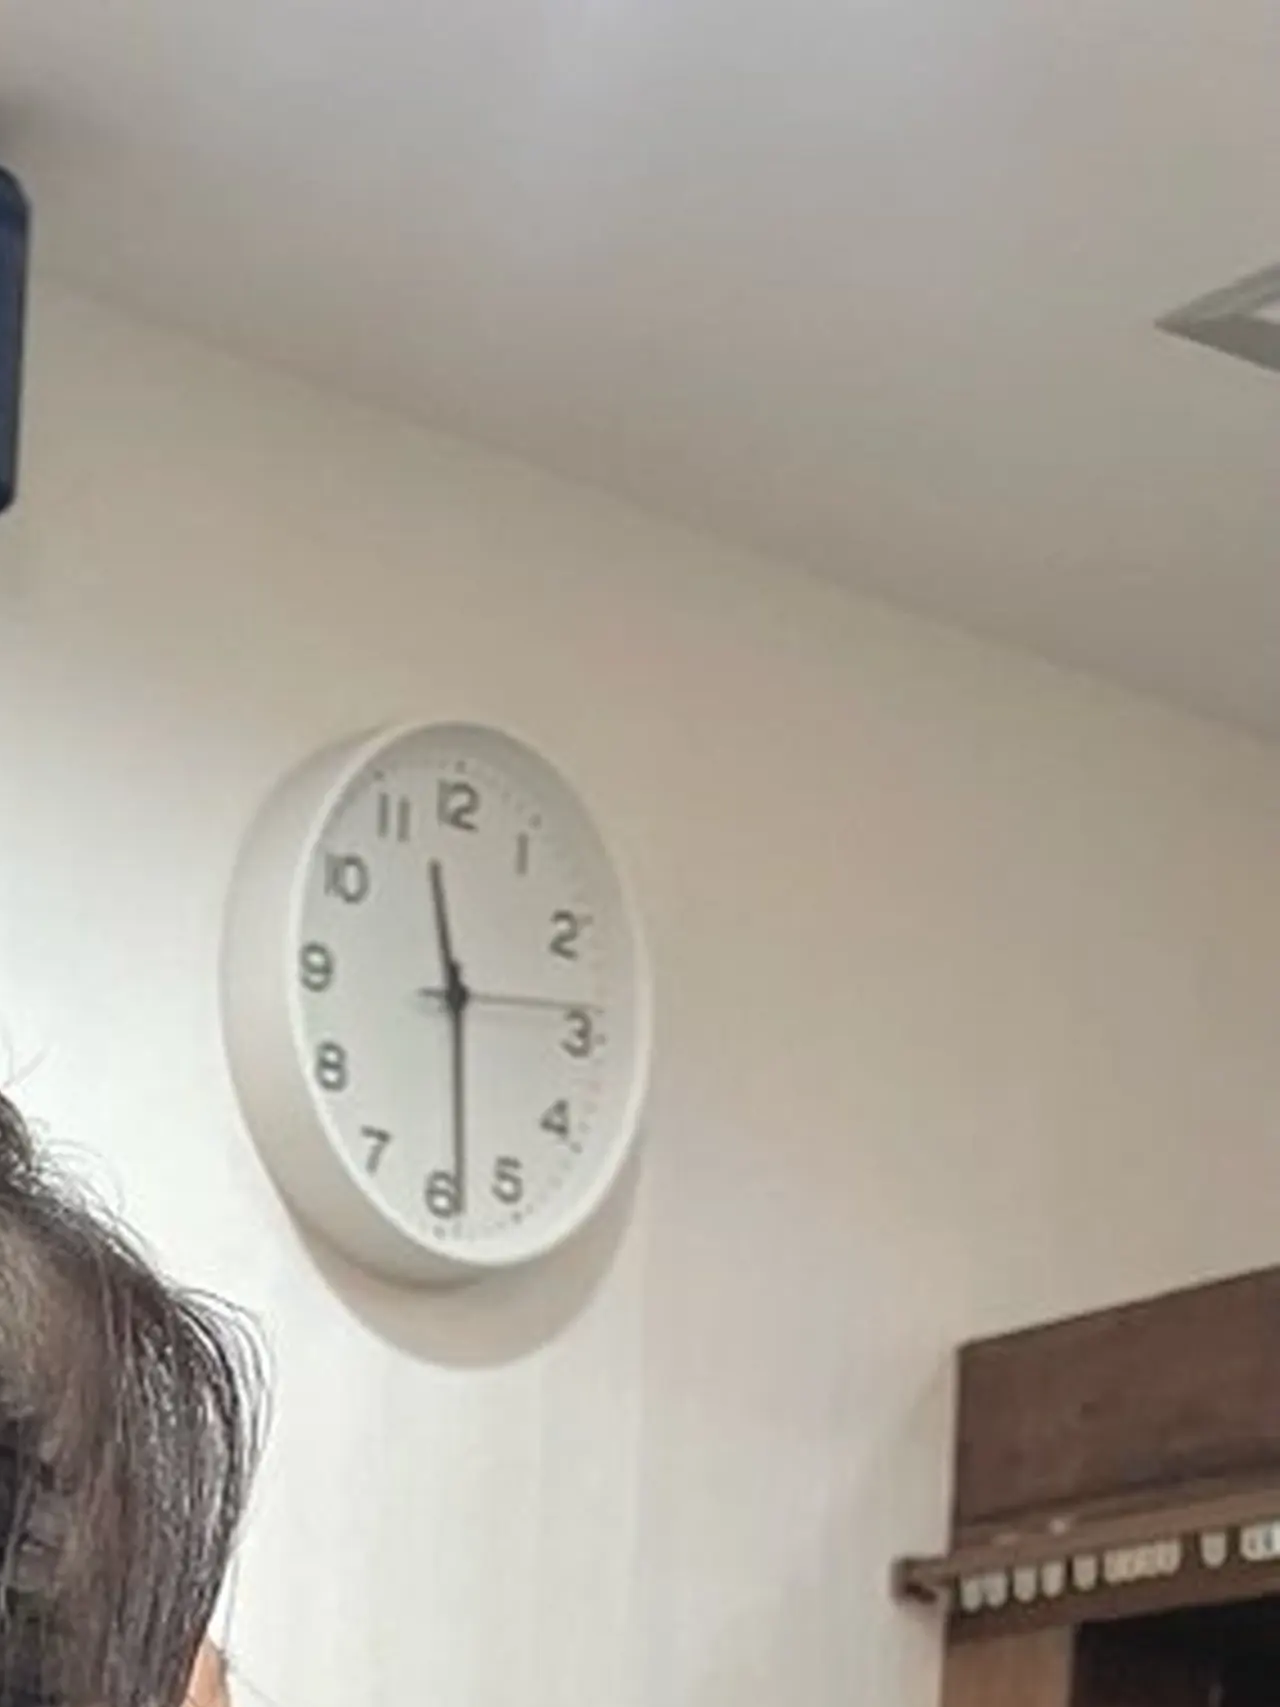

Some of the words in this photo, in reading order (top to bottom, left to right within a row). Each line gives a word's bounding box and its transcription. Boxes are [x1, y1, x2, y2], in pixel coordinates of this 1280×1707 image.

[376, 792, 411, 842] 11
[436, 778, 480, 832] 12
[324, 852, 371, 905] 10
[515, 832, 530, 876] 1
[549, 908, 578, 961] 2
[298, 941, 334, 992] 9
[560, 1007, 593, 1059] 3
[315, 1040, 348, 1091] 8
[539, 1098, 570, 1138] 4
[360, 1124, 392, 1174] 7
[424, 1169, 461, 1219] 6
[491, 1155, 522, 1205] 5
